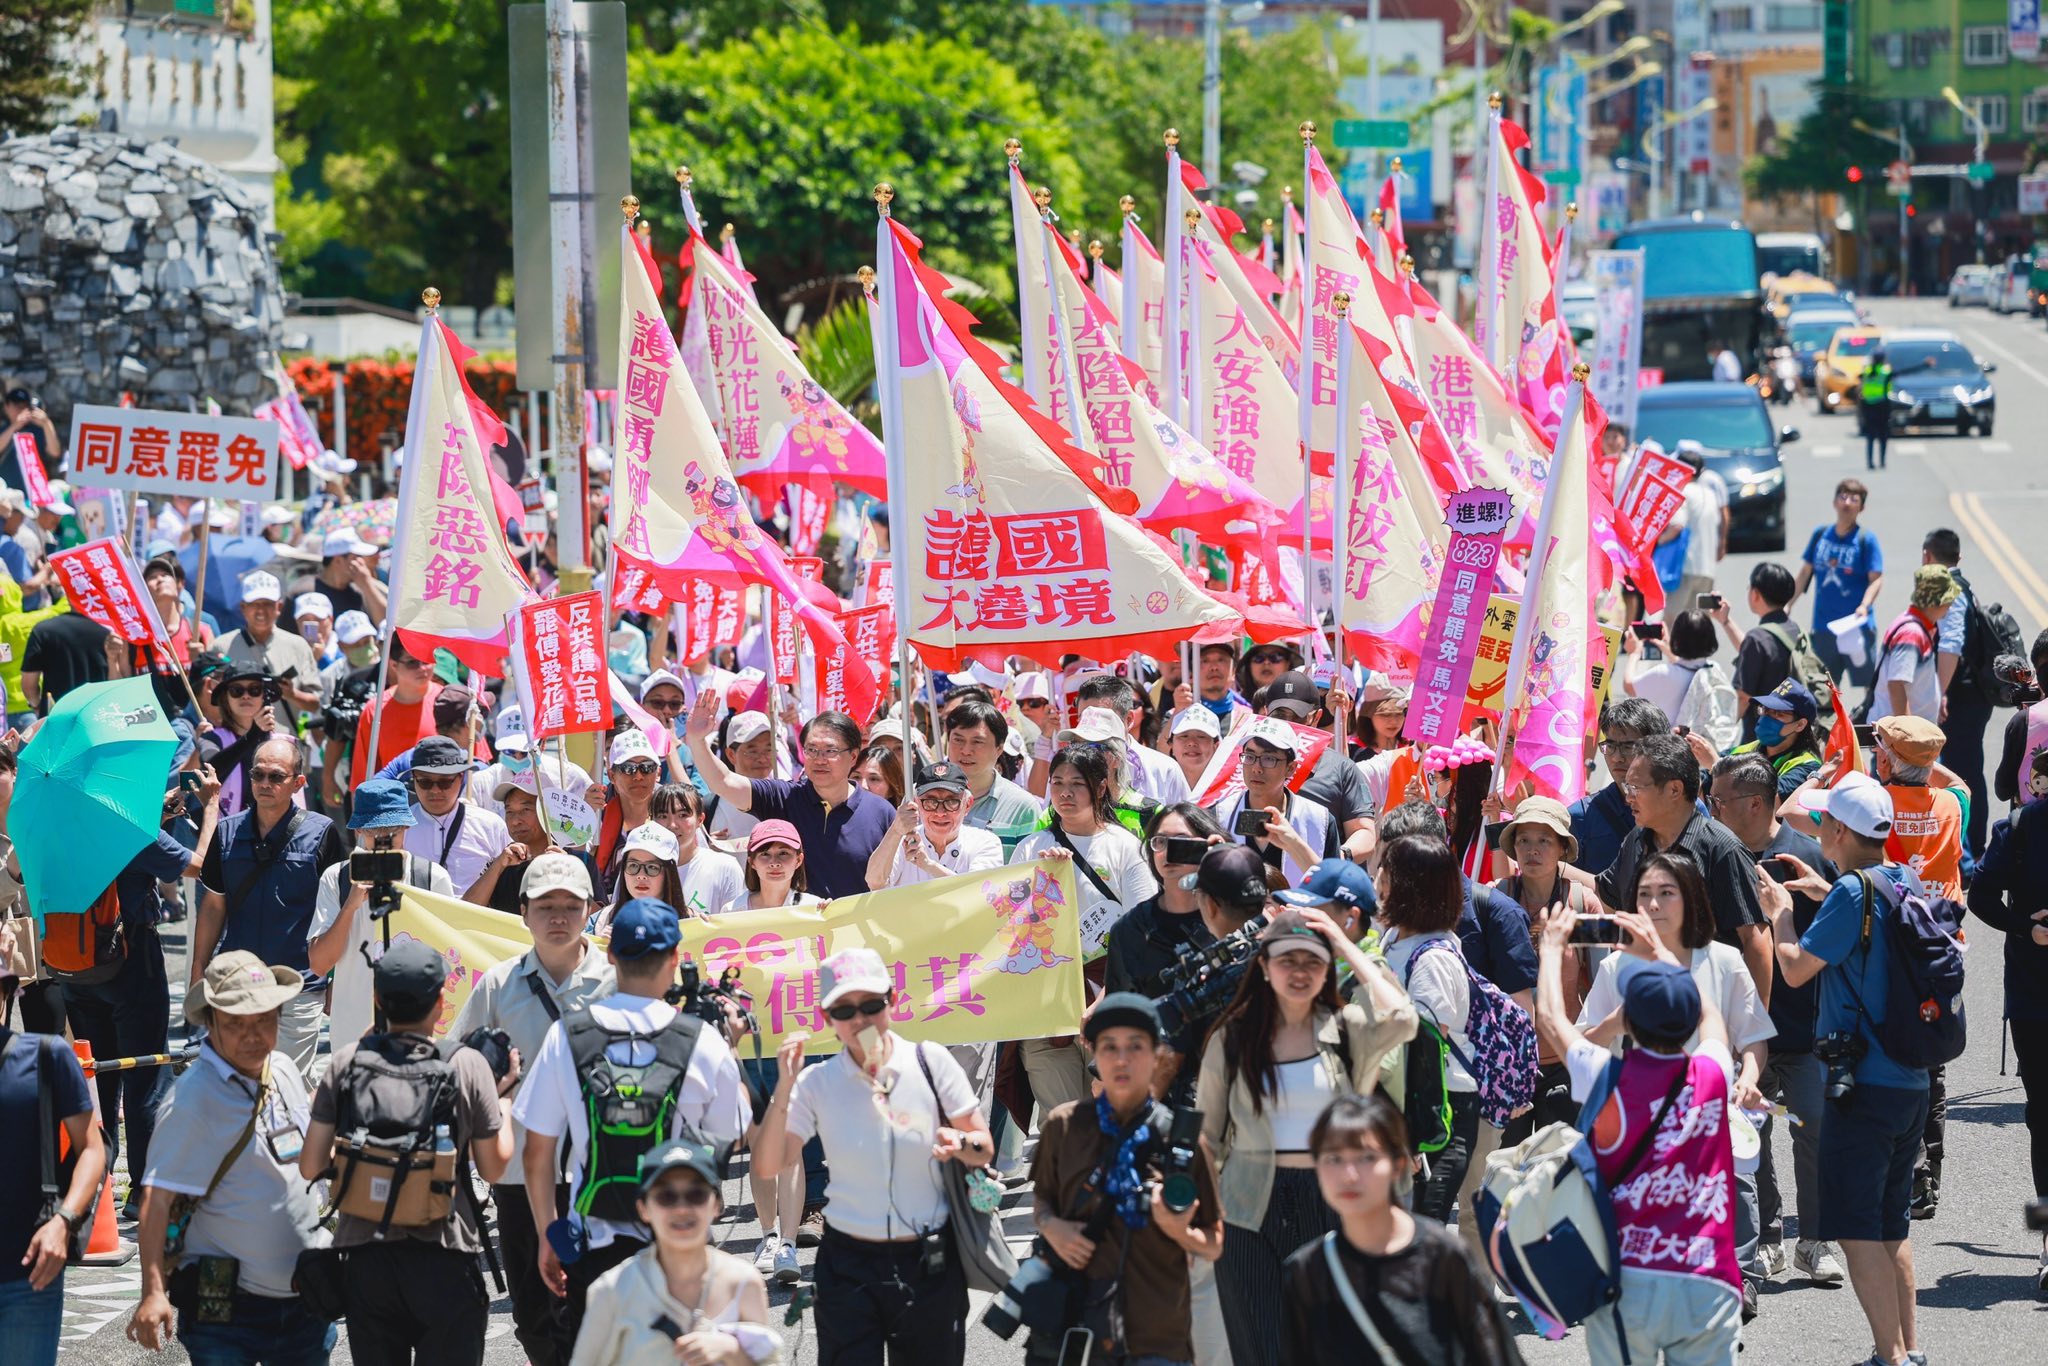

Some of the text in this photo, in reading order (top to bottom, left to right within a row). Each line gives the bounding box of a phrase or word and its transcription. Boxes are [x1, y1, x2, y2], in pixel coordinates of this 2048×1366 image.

[75, 423, 267, 486] 同意罷免
[924, 507, 1111, 581] 護國
[1456, 501, 1504, 524] 進螺!
[1452, 538, 1496, 568] 823
[918, 578, 1116, 631] 大遶境
[533, 608, 566, 730] 罷傅愛花蓮
[569, 601, 602, 725] 反共護台灣
[1418, 570, 1479, 738] 同意罷免 馬文君
